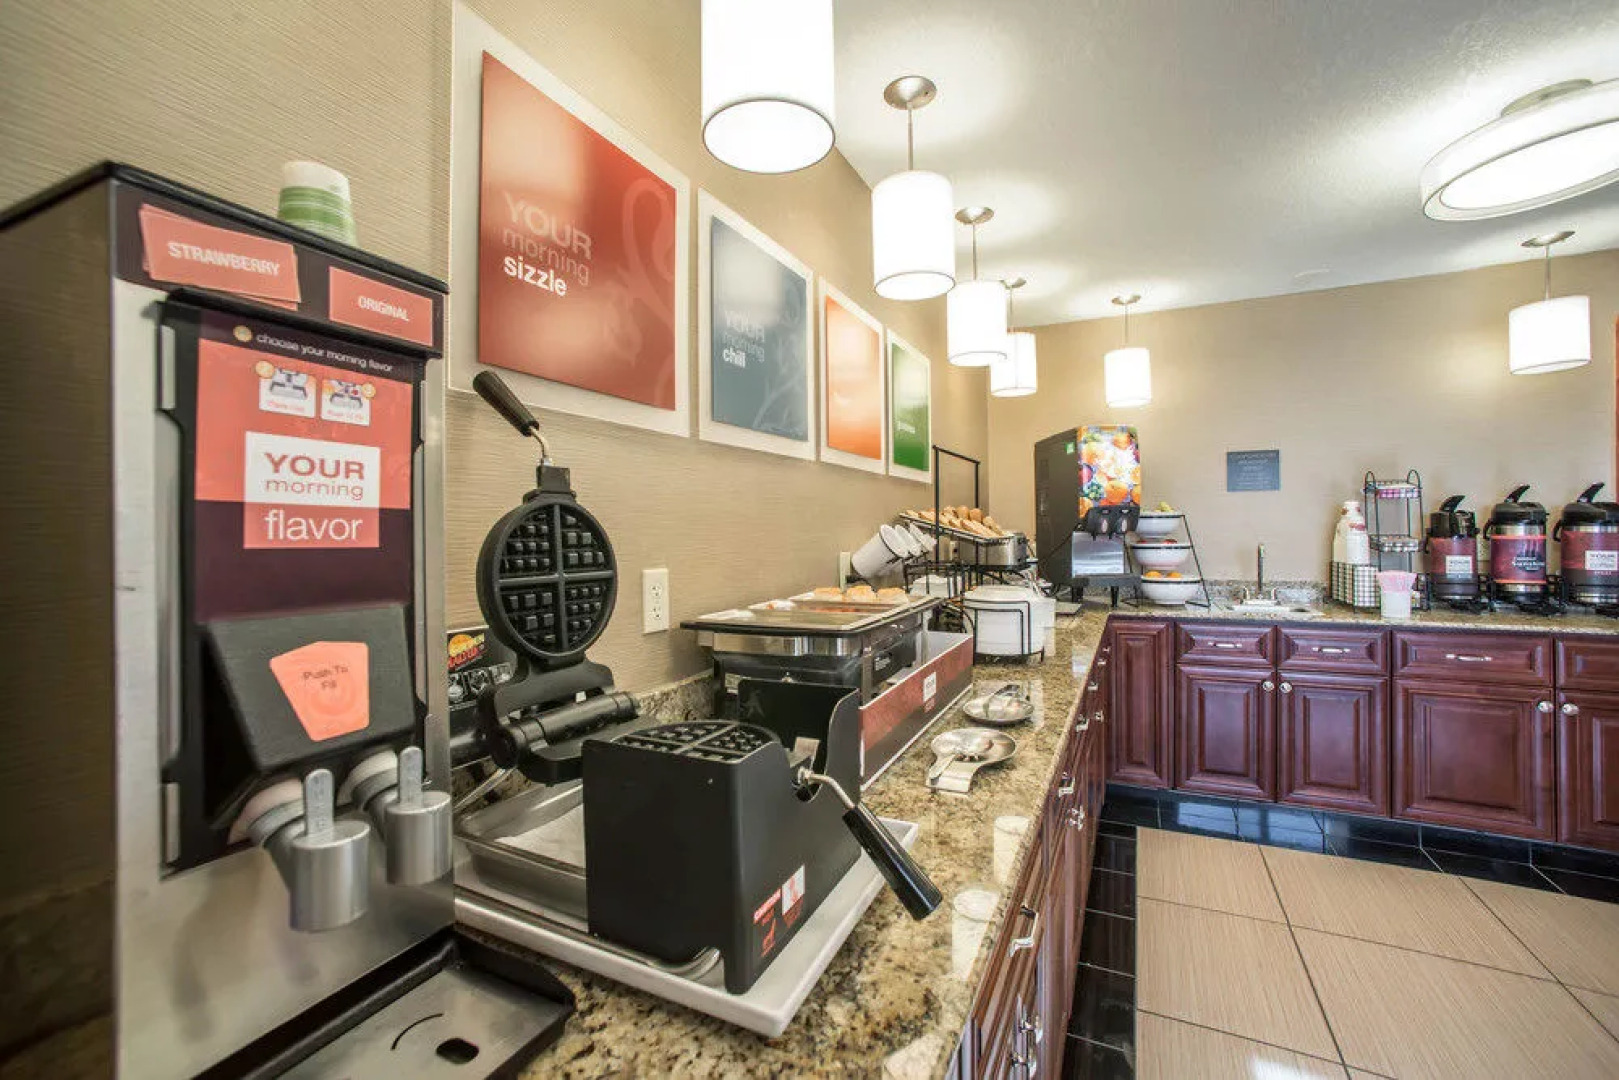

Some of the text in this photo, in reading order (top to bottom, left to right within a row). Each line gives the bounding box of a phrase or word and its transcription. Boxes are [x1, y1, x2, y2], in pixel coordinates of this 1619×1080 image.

[504, 190, 592, 260] YOUR
[167, 241, 281, 278] STRAWBERRY
[503, 227, 590, 287] morning
[503, 255, 568, 297] sizzle
[357, 295, 409, 322] ORIGINAL
[256, 333, 393, 373] choose your morning flavor
[263, 452, 365, 481] YOUR
[265, 478, 364, 501] morning
[264, 507, 364, 541] flavor
